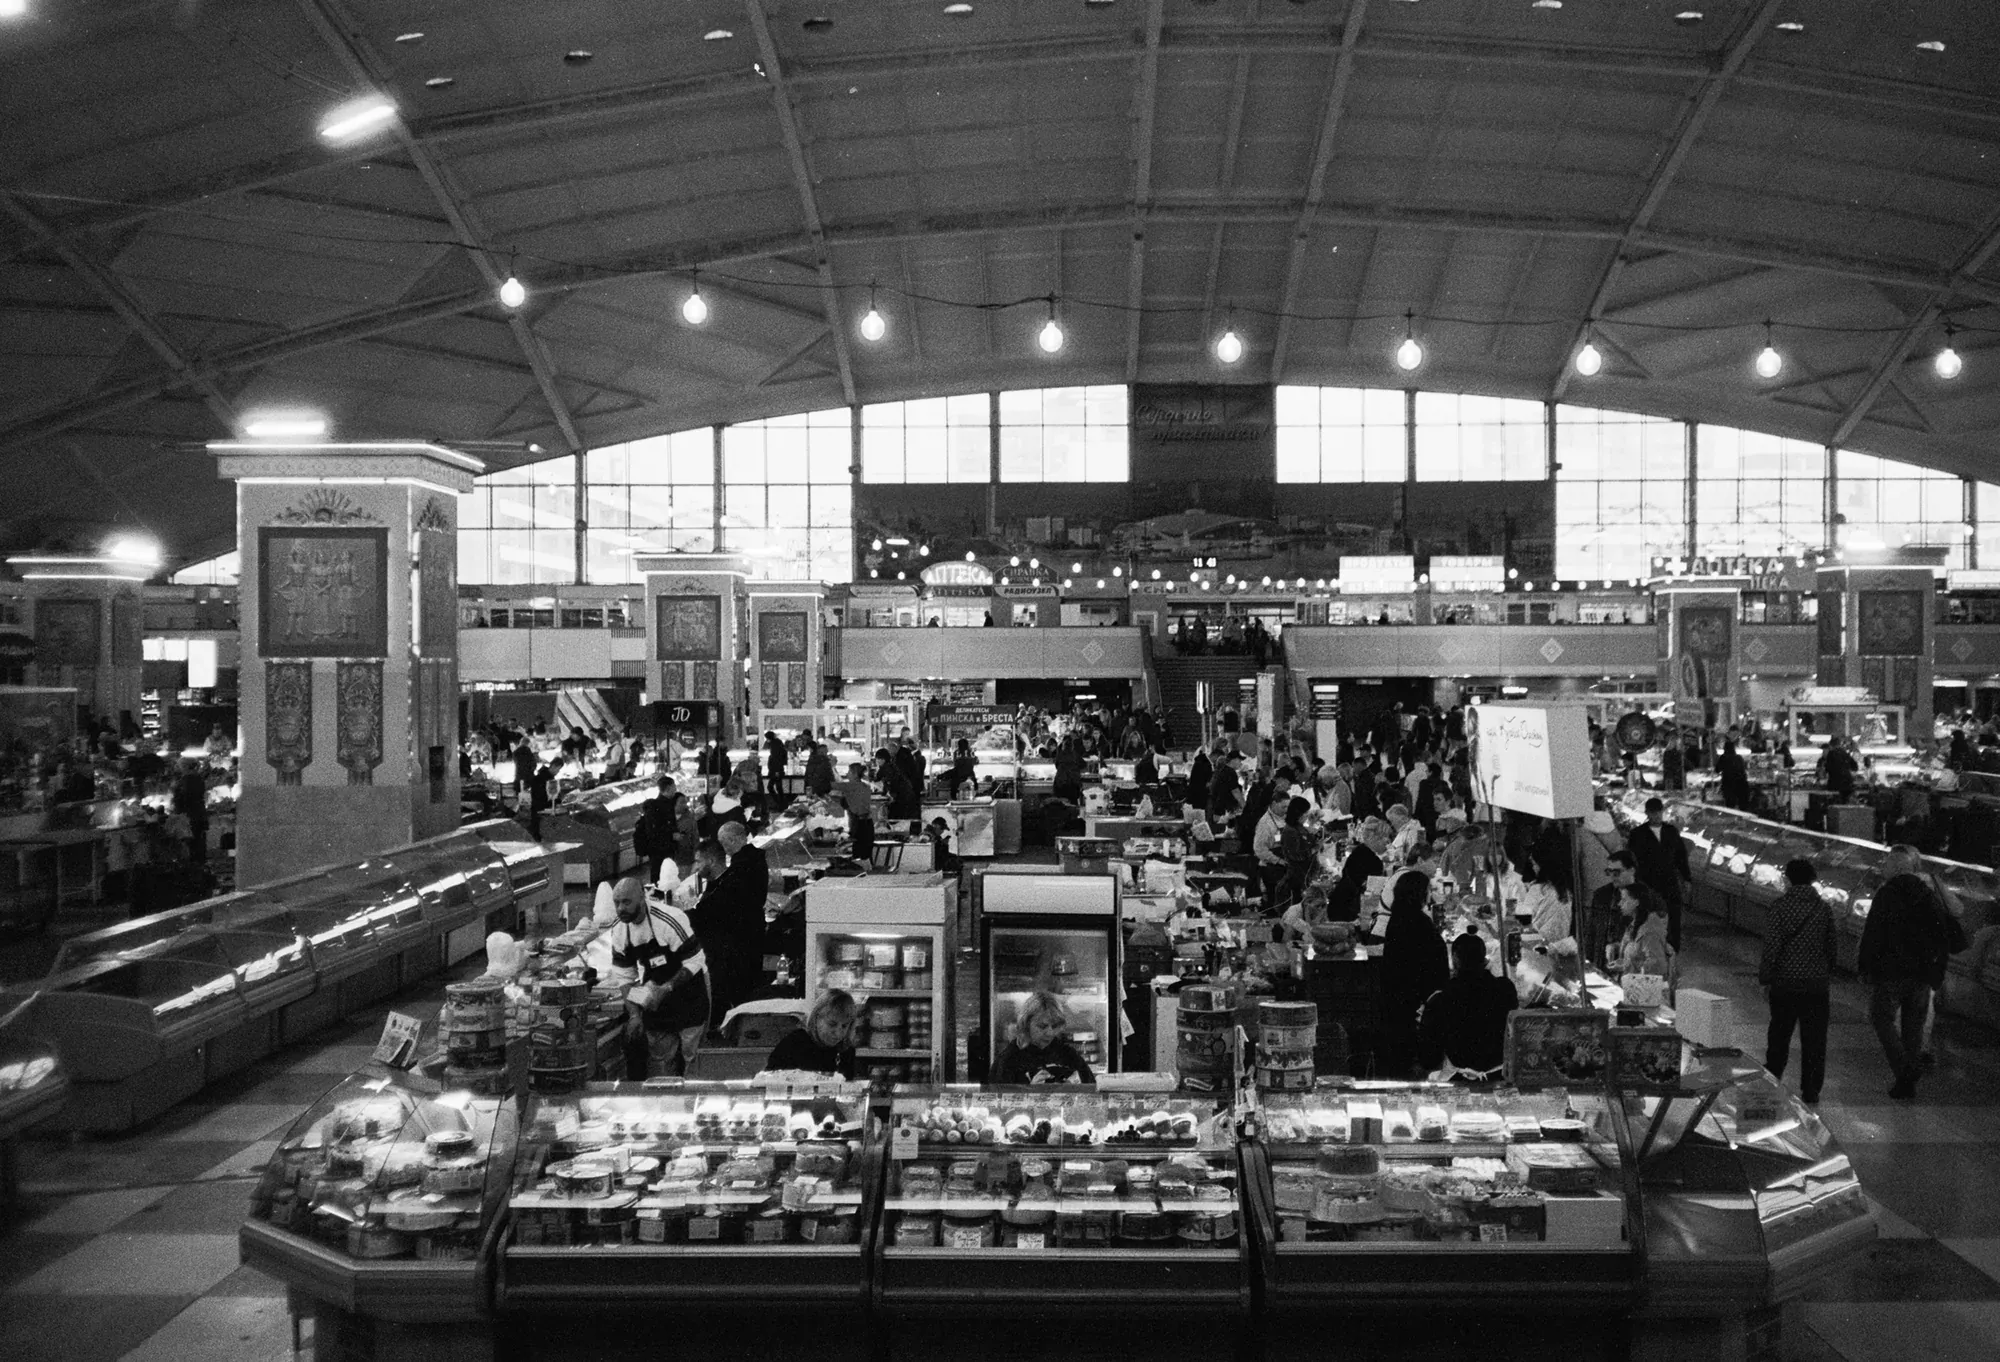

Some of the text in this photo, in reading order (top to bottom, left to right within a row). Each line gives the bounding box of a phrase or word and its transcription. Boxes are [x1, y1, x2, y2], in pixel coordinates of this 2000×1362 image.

[925, 564, 986, 585] АПТЕКА
[1003, 567, 1050, 577] СПРАВКА
[1692, 558, 1780, 575] АПТЕКА
[671, 706, 690, 722] JD
[941, 714, 974, 723] ПИНСКА
[982, 713, 1013, 722] БРЕСТА
